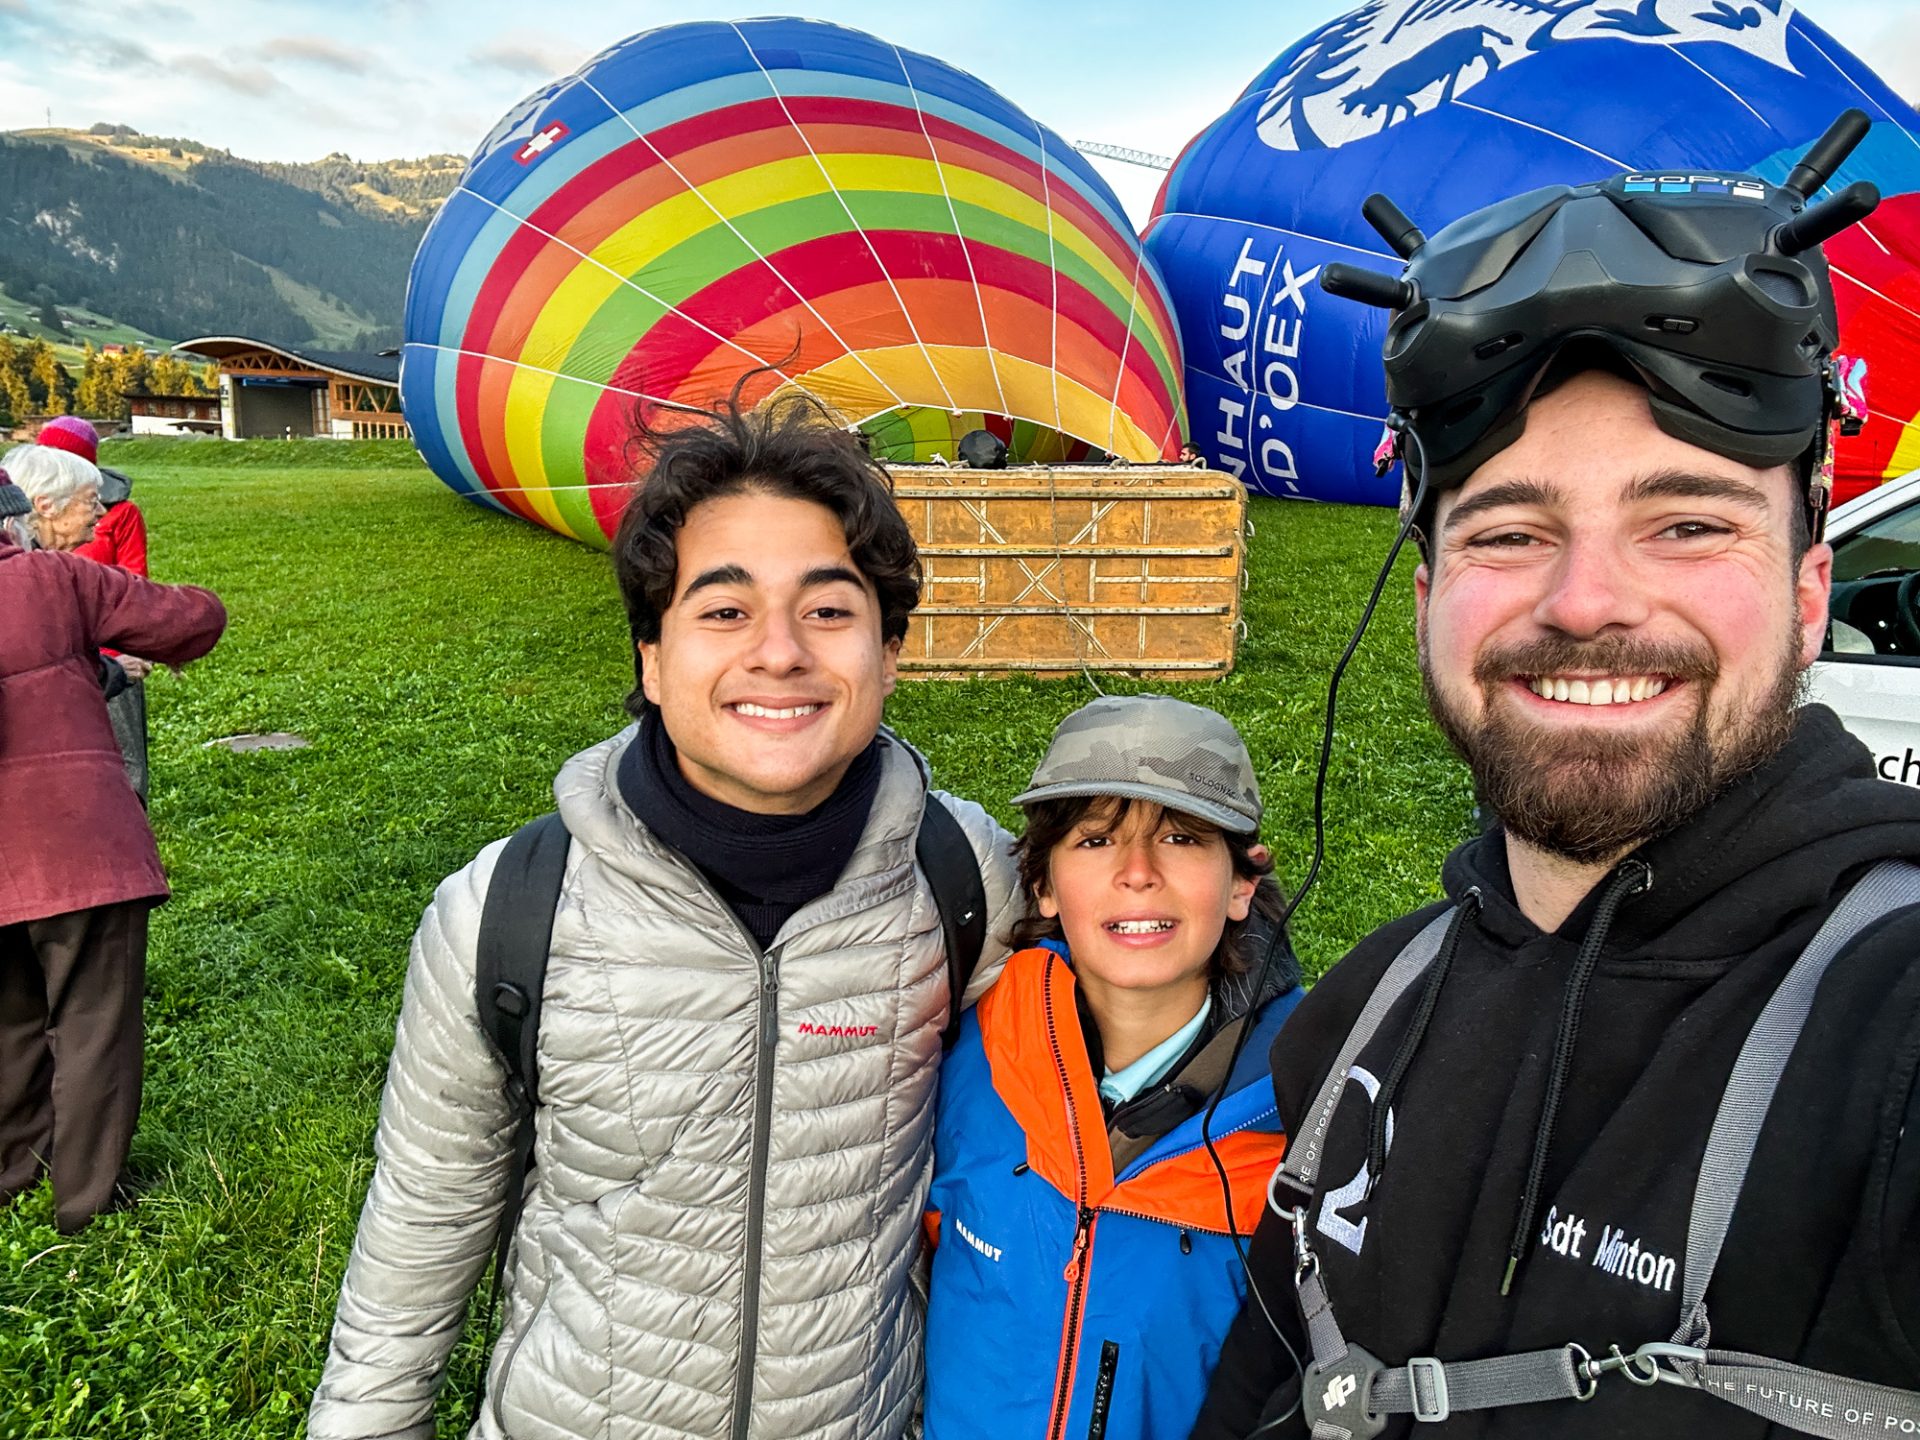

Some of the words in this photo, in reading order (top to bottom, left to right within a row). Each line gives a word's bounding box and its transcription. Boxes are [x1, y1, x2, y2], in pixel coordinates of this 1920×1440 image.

[1625, 174, 1765, 190] GoPro
[1872, 748, 1920, 786] ch
[798, 1022, 878, 1037] MAMMUT
[1306, 1141, 1318, 1161] OF
[1314, 1068, 1347, 1137] POSSIBLE
[956, 1218, 1002, 1262] MAMMUT
[1592, 1224, 1676, 1292] Minton
[1746, 1384, 1833, 1418] FUTURE
[1844, 1409, 1874, 1426] OF
